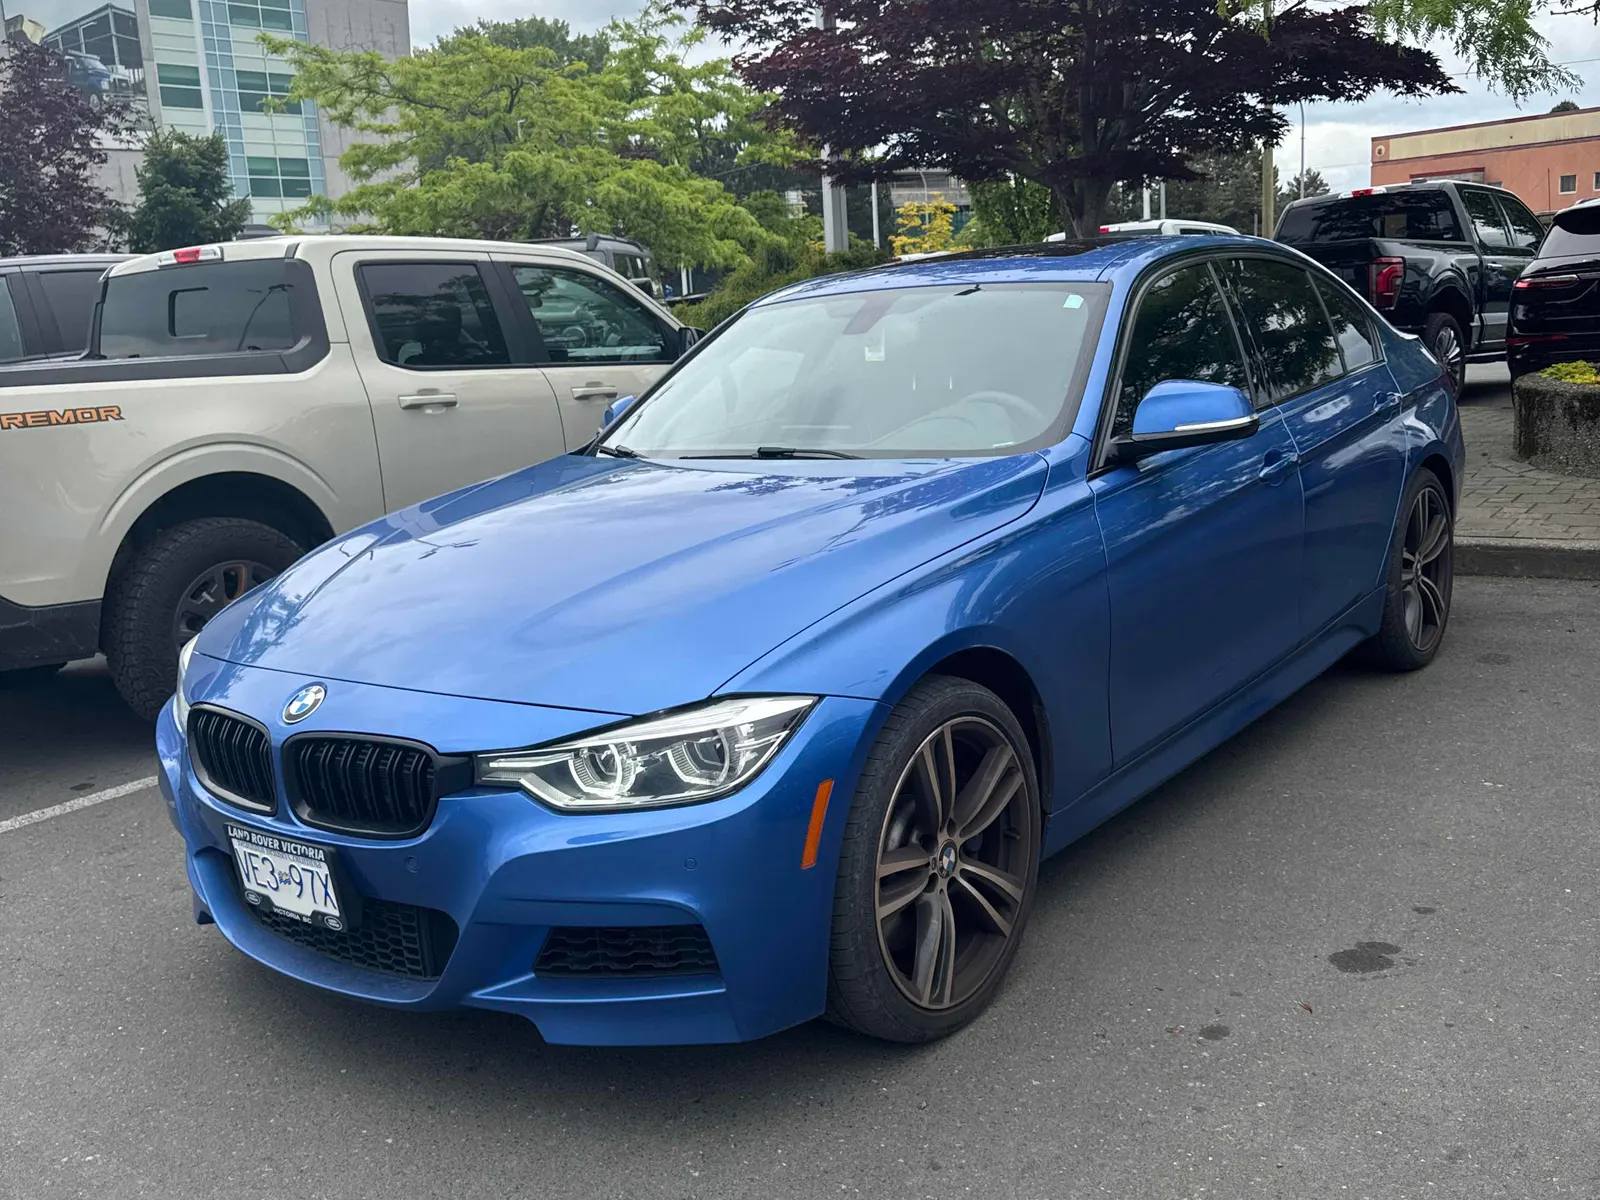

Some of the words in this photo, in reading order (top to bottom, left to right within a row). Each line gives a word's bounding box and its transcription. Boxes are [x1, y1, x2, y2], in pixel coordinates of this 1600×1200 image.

[0, 405, 125, 430] REMOR
[228, 825, 250, 841] LAND
[251, 832, 279, 850] ROVER
[281, 841, 325, 861] VICTORIA
